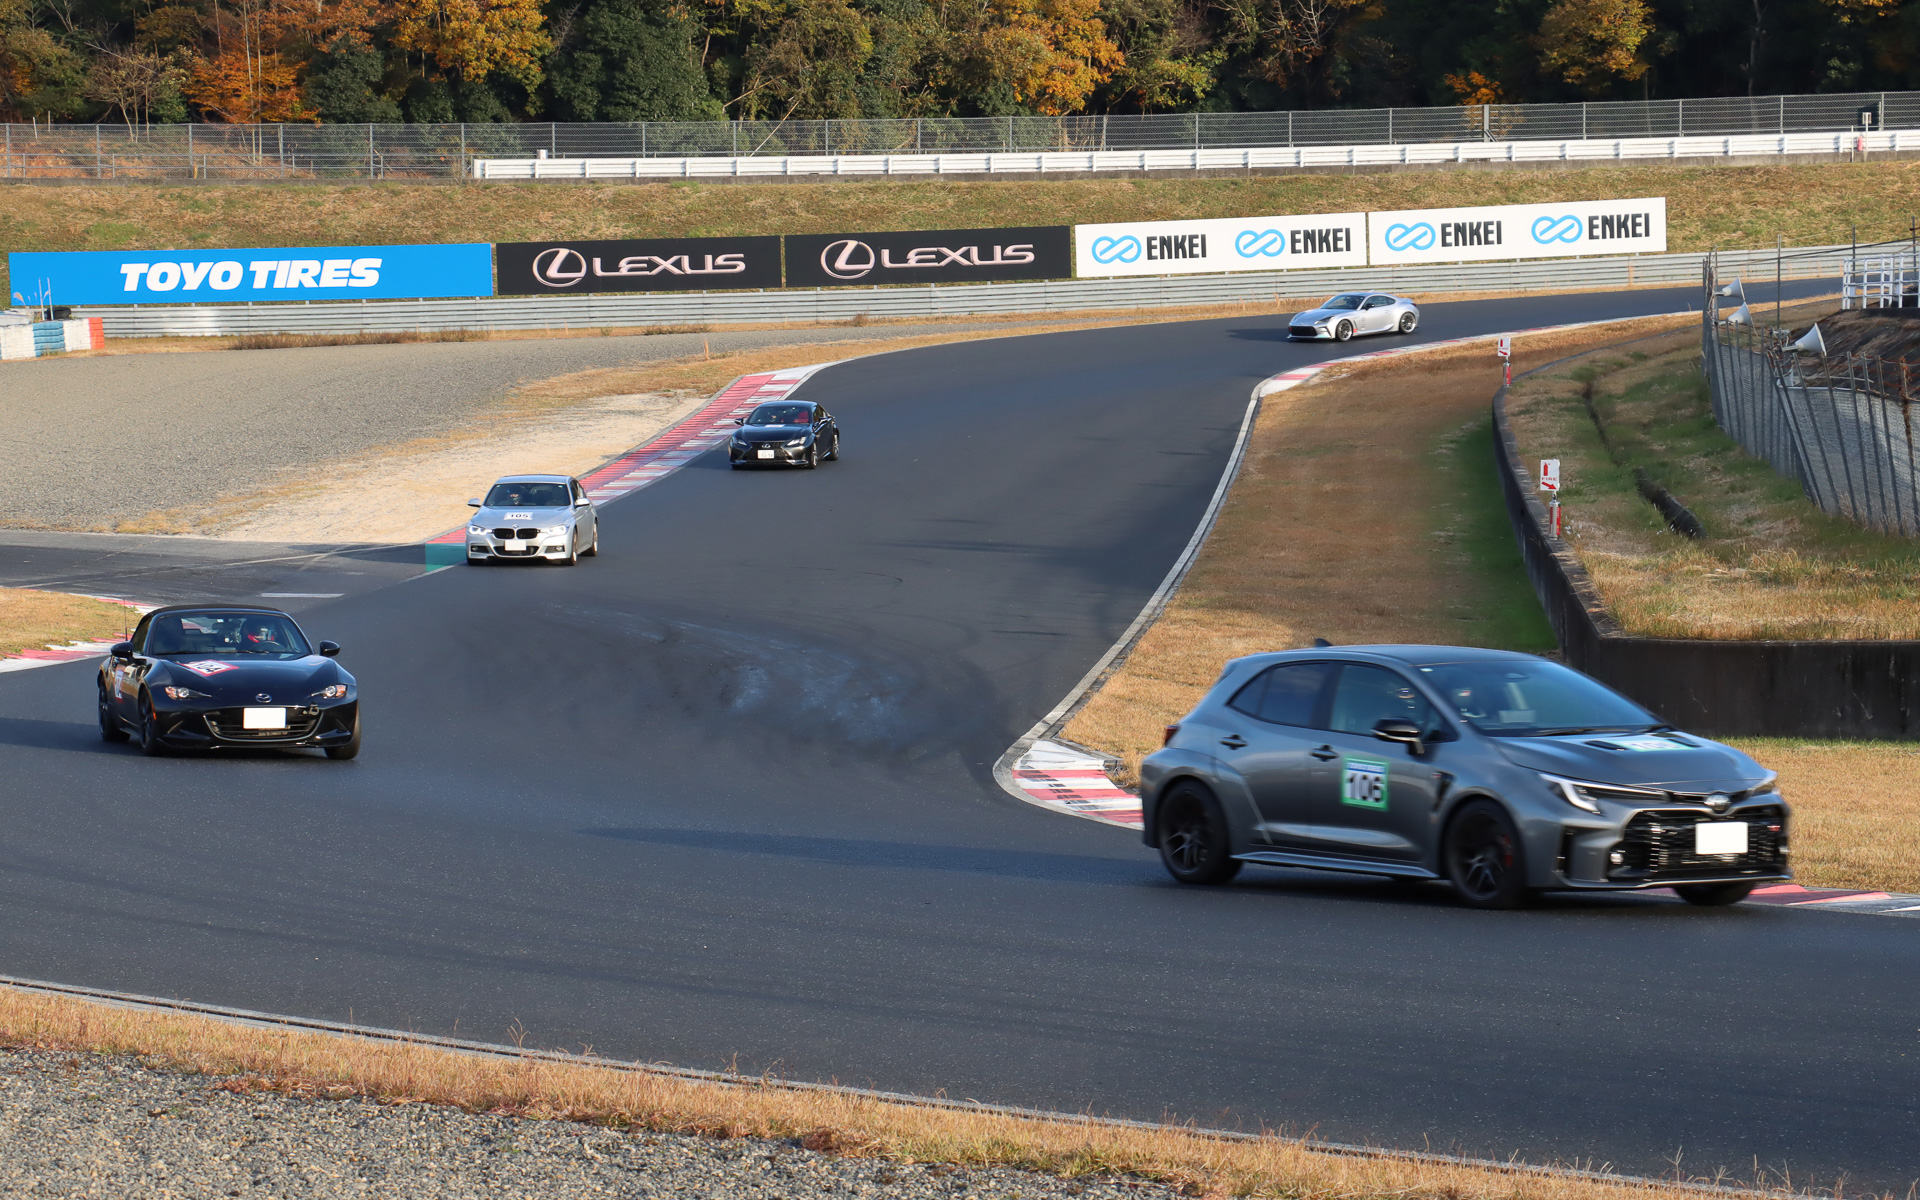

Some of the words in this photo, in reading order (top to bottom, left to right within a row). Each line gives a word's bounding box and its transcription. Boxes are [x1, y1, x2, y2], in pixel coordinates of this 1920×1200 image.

[1441, 220, 1502, 248] ENKEI
[1588, 213, 1650, 240] ENKEI
[1146, 234, 1207, 261] ENKEI
[1290, 227, 1351, 254] ENKEI
[593, 254, 746, 276] LEXUS
[881, 244, 1035, 269] LEXUS
[120, 260, 243, 291] TOYO
[249, 258, 382, 289] TIRES
[1349, 773, 1385, 803] 106
